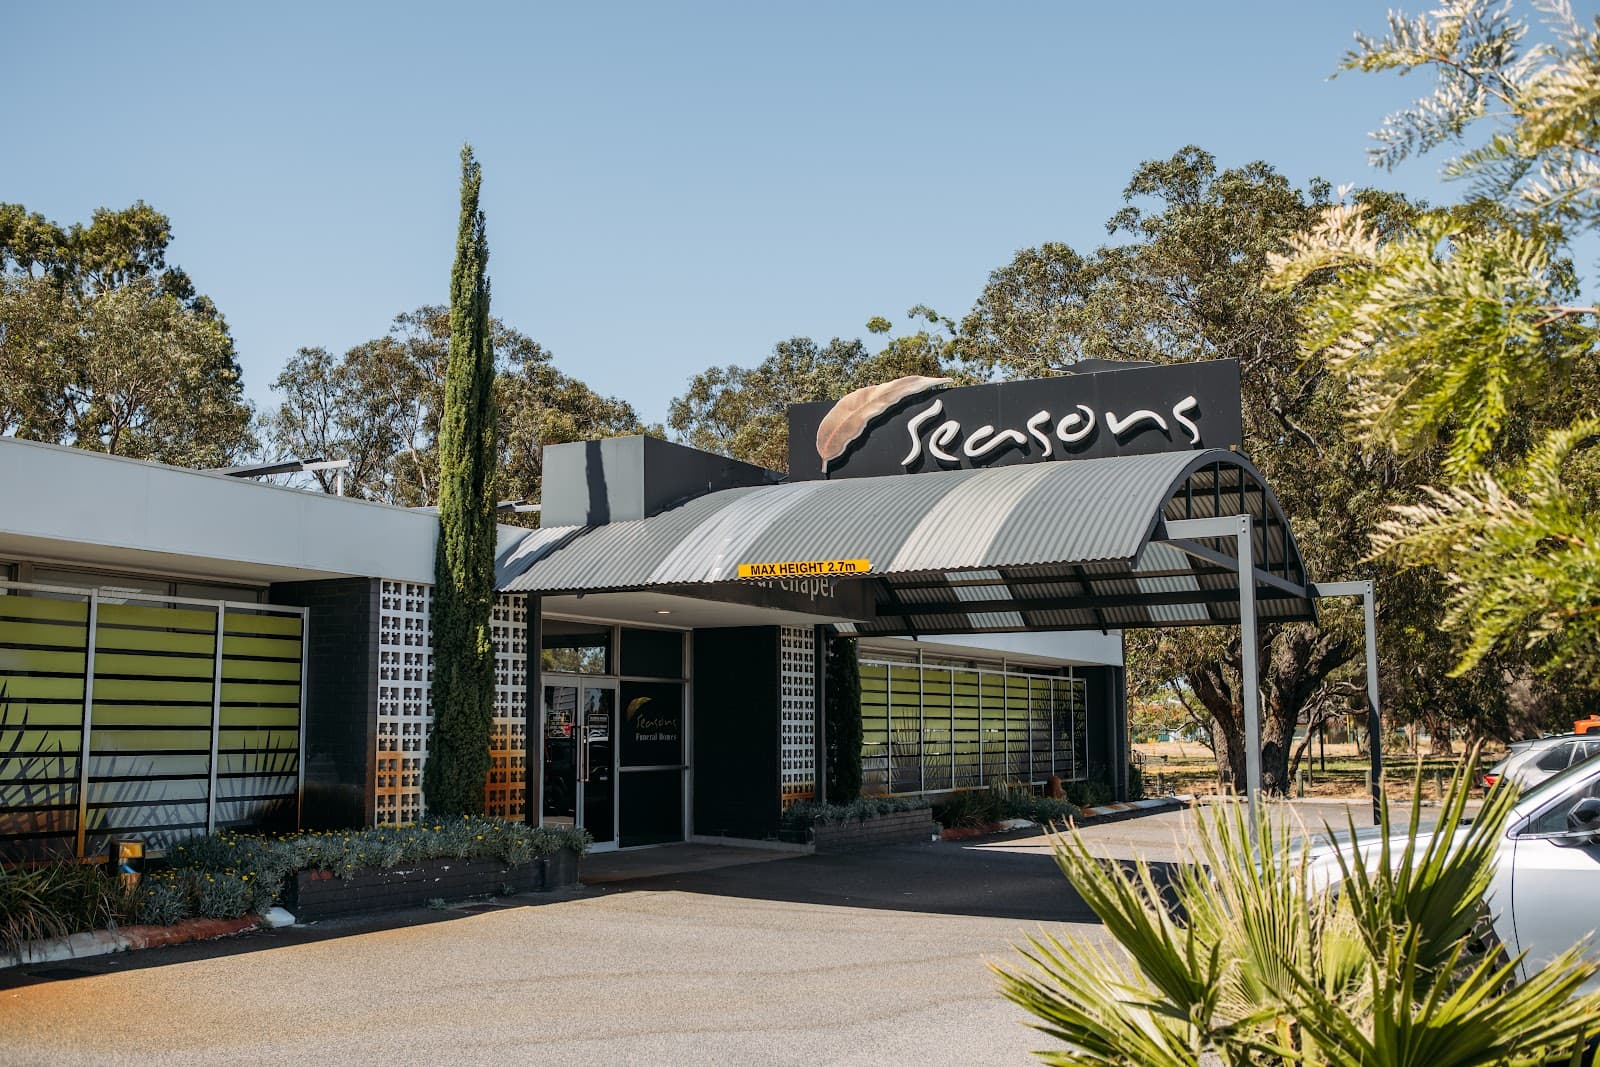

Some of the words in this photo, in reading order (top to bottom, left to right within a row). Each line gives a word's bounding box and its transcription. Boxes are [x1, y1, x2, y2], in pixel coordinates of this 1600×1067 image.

[900, 394, 1202, 466] Seasons
[751, 564, 777, 575] MAX
[780, 562, 824, 574] HEIGHT
[828, 561, 856, 572] 2.7m
